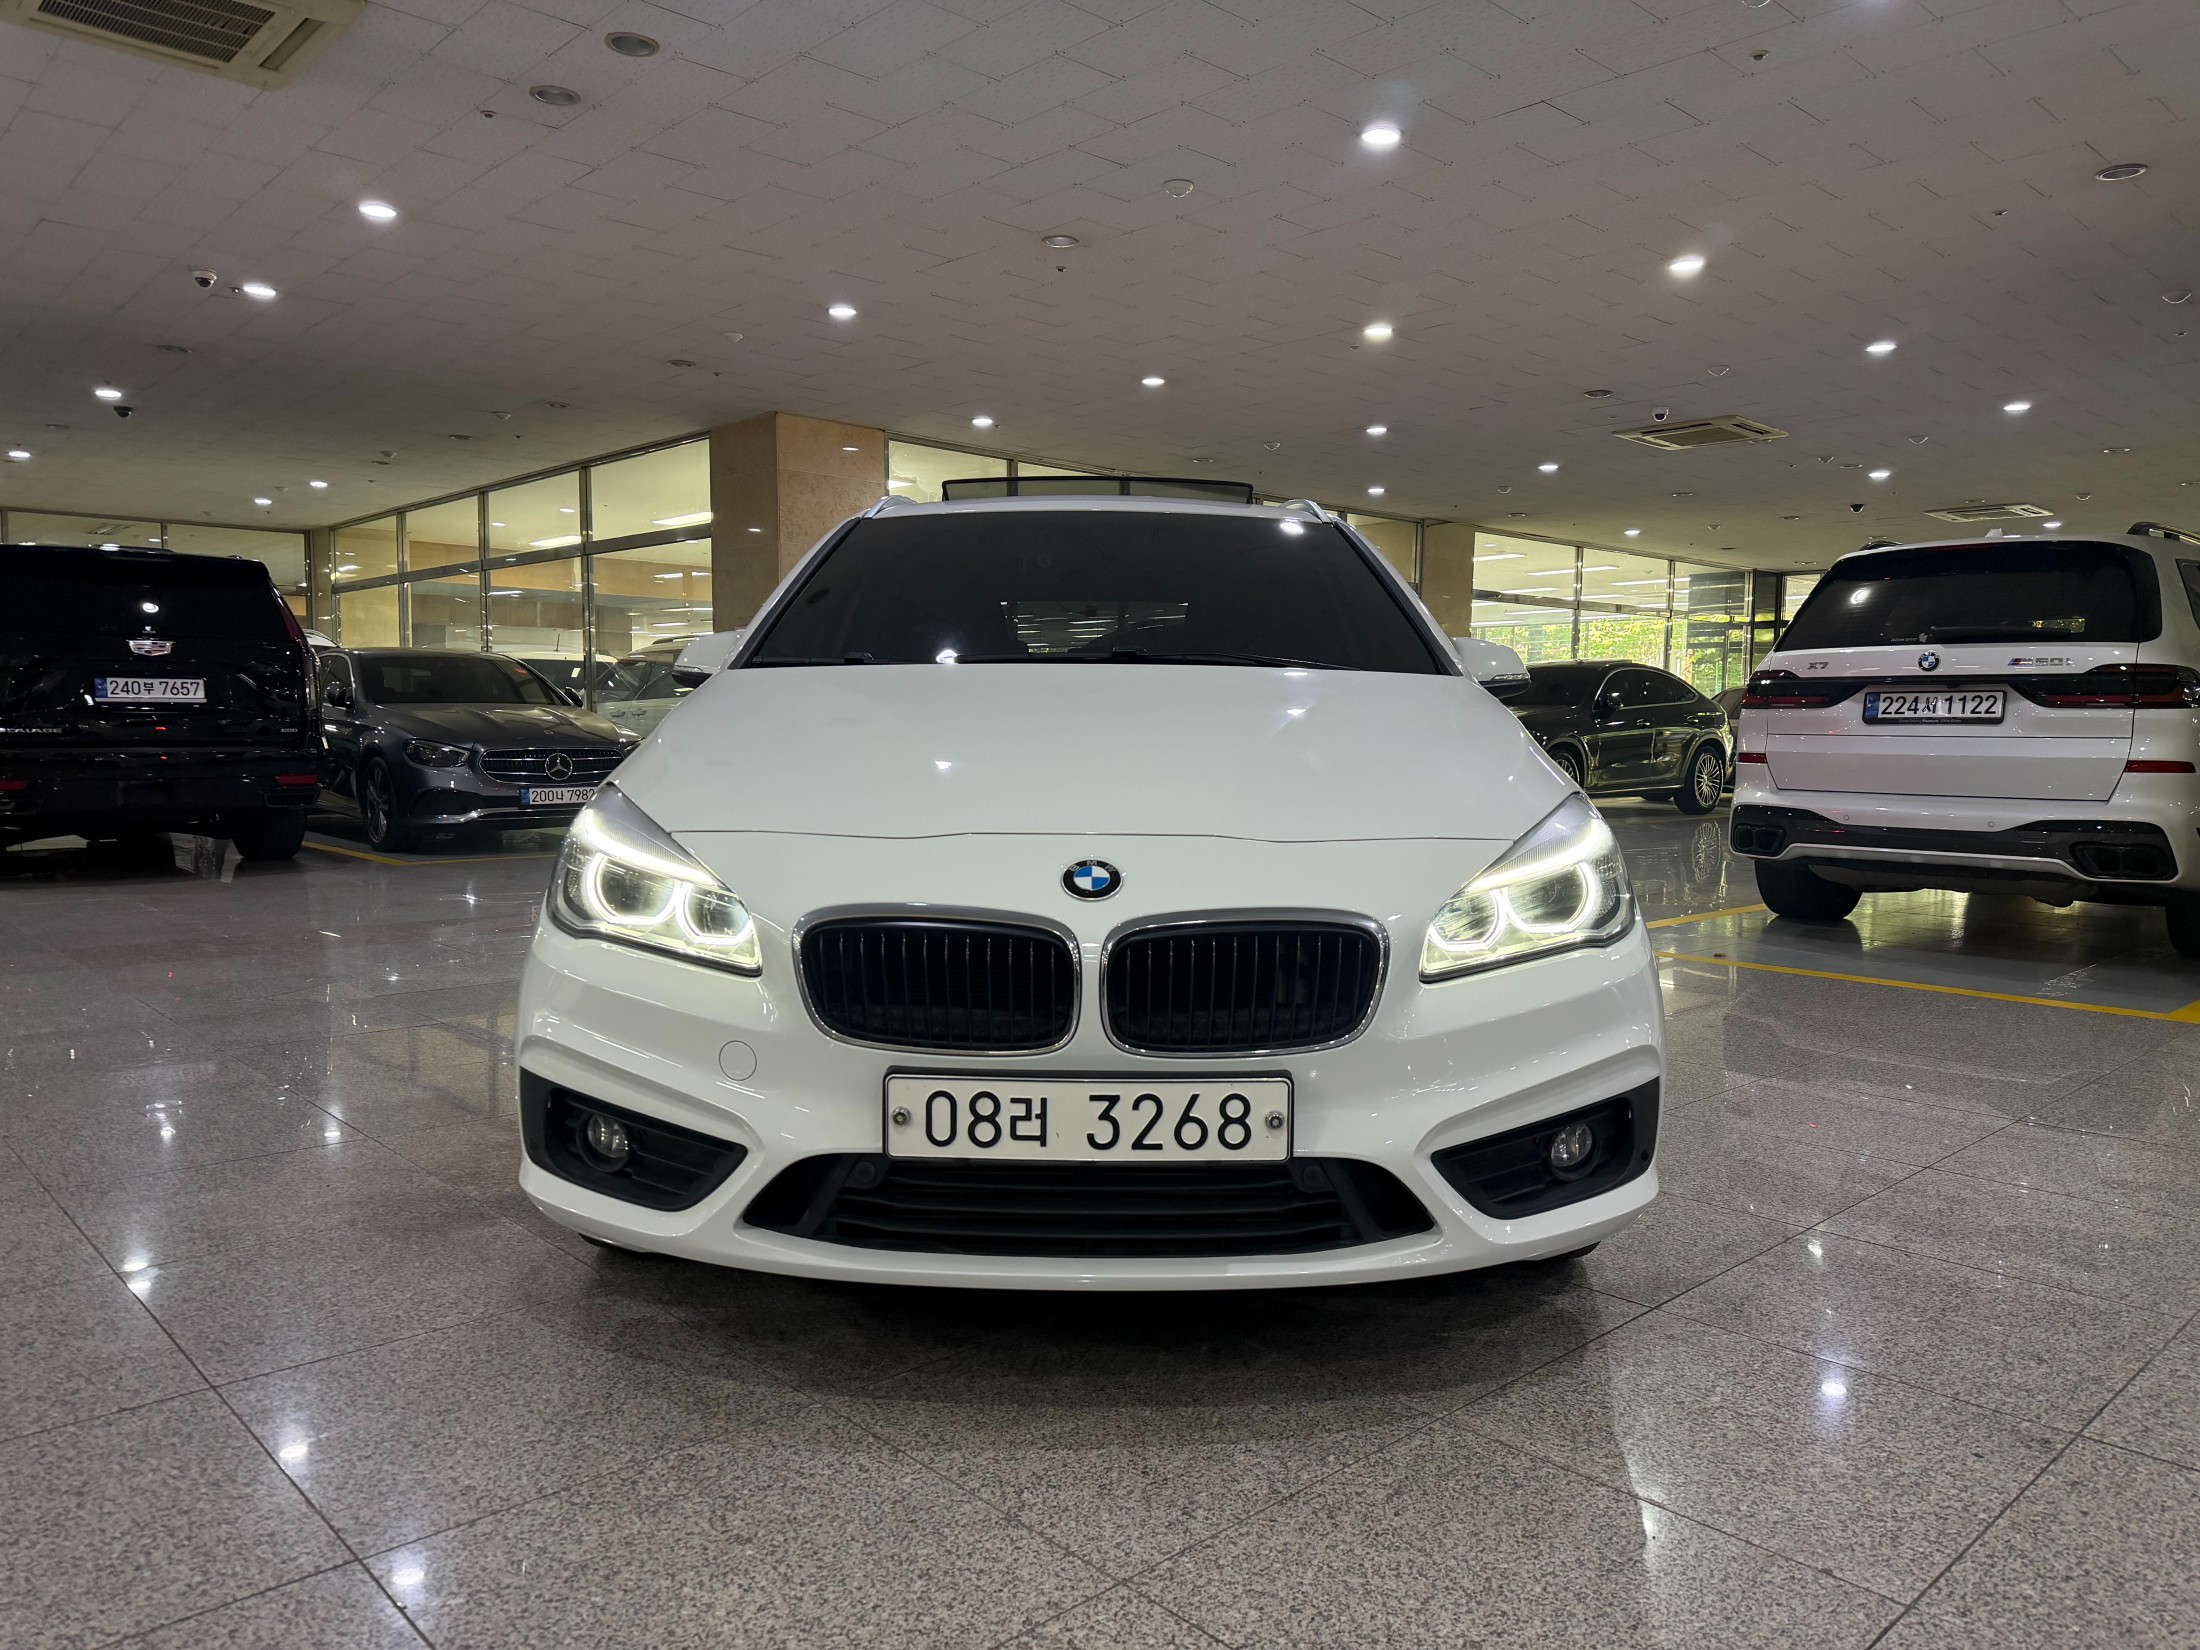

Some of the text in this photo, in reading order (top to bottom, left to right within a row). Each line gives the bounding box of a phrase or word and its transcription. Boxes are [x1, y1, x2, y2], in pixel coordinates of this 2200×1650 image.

[1806, 661, 1829, 670] X7
[109, 680, 200, 696] 240부 7657
[1944, 694, 1998, 715] 1122
[531, 789, 564, 803] 200나
[1068, 860, 1117, 872] BMW
[925, 1089, 1253, 1151] 08러 3268
